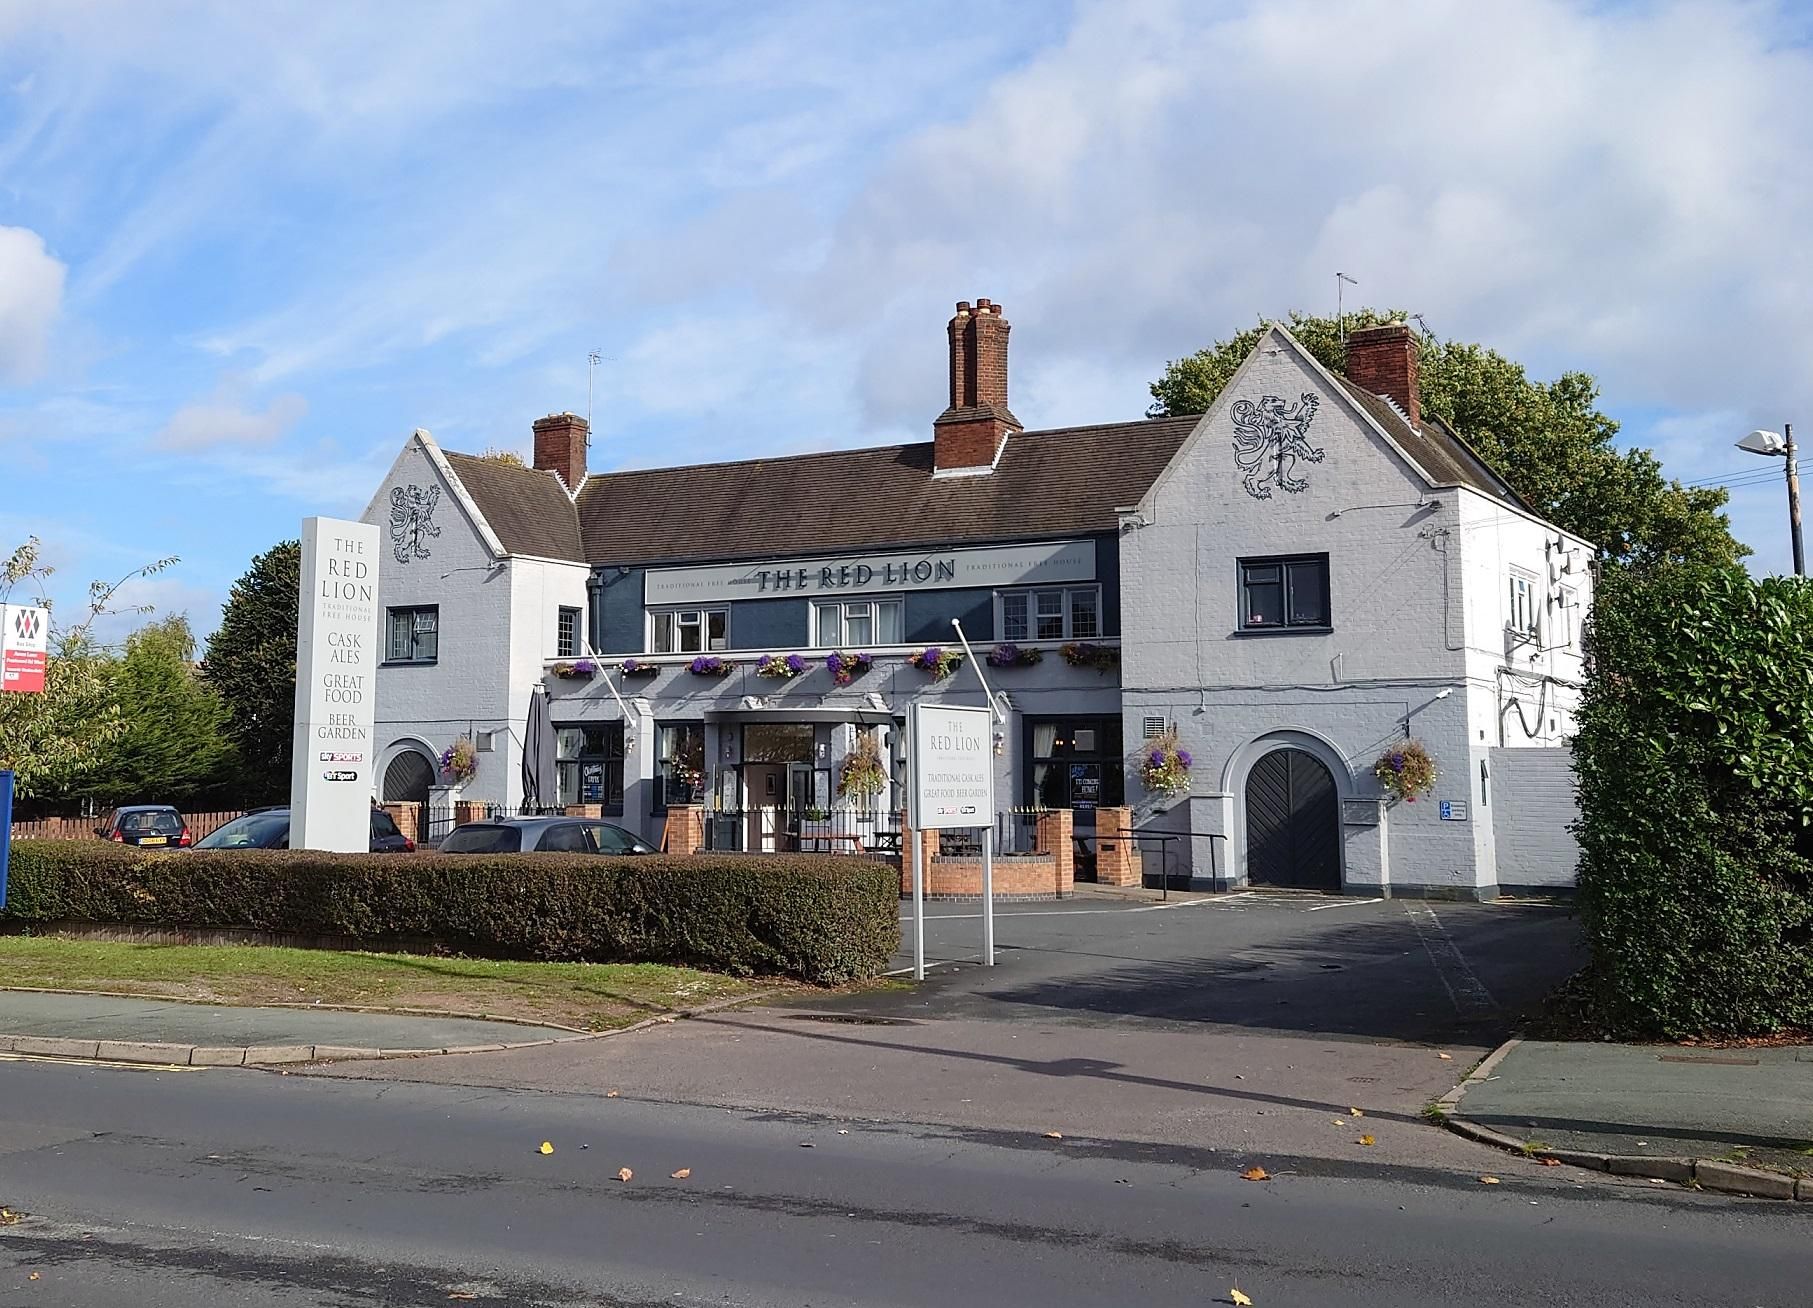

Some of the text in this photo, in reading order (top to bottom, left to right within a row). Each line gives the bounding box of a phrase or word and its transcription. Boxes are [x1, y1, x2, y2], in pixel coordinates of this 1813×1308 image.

[334, 538, 363, 554] THE
[329, 558, 367, 579] RED
[966, 561, 1024, 570] TRADITIONAL
[755, 559, 956, 590] THE RED LION
[322, 580, 372, 602] LION
[656, 582, 704, 590] TRADITIONAL
[323, 603, 371, 613] TRADITIONAL
[322, 611, 371, 622] FREE HOUSE
[328, 632, 362, 648] CASK
[330, 649, 360, 664] ALES
[323, 673, 364, 689] GREAT
[325, 689, 362, 704] FOOD
[329, 713, 356, 726] BEER
[948, 720, 963, 733] THE
[318, 727, 366, 740] GARDEN
[930, 735, 981, 752] RED LION
[337, 772, 355, 780] Sport
[928, 773, 961, 783] TRADITIONAL
[923, 788, 988, 798] GREAT FOOD BEER GARDEN
